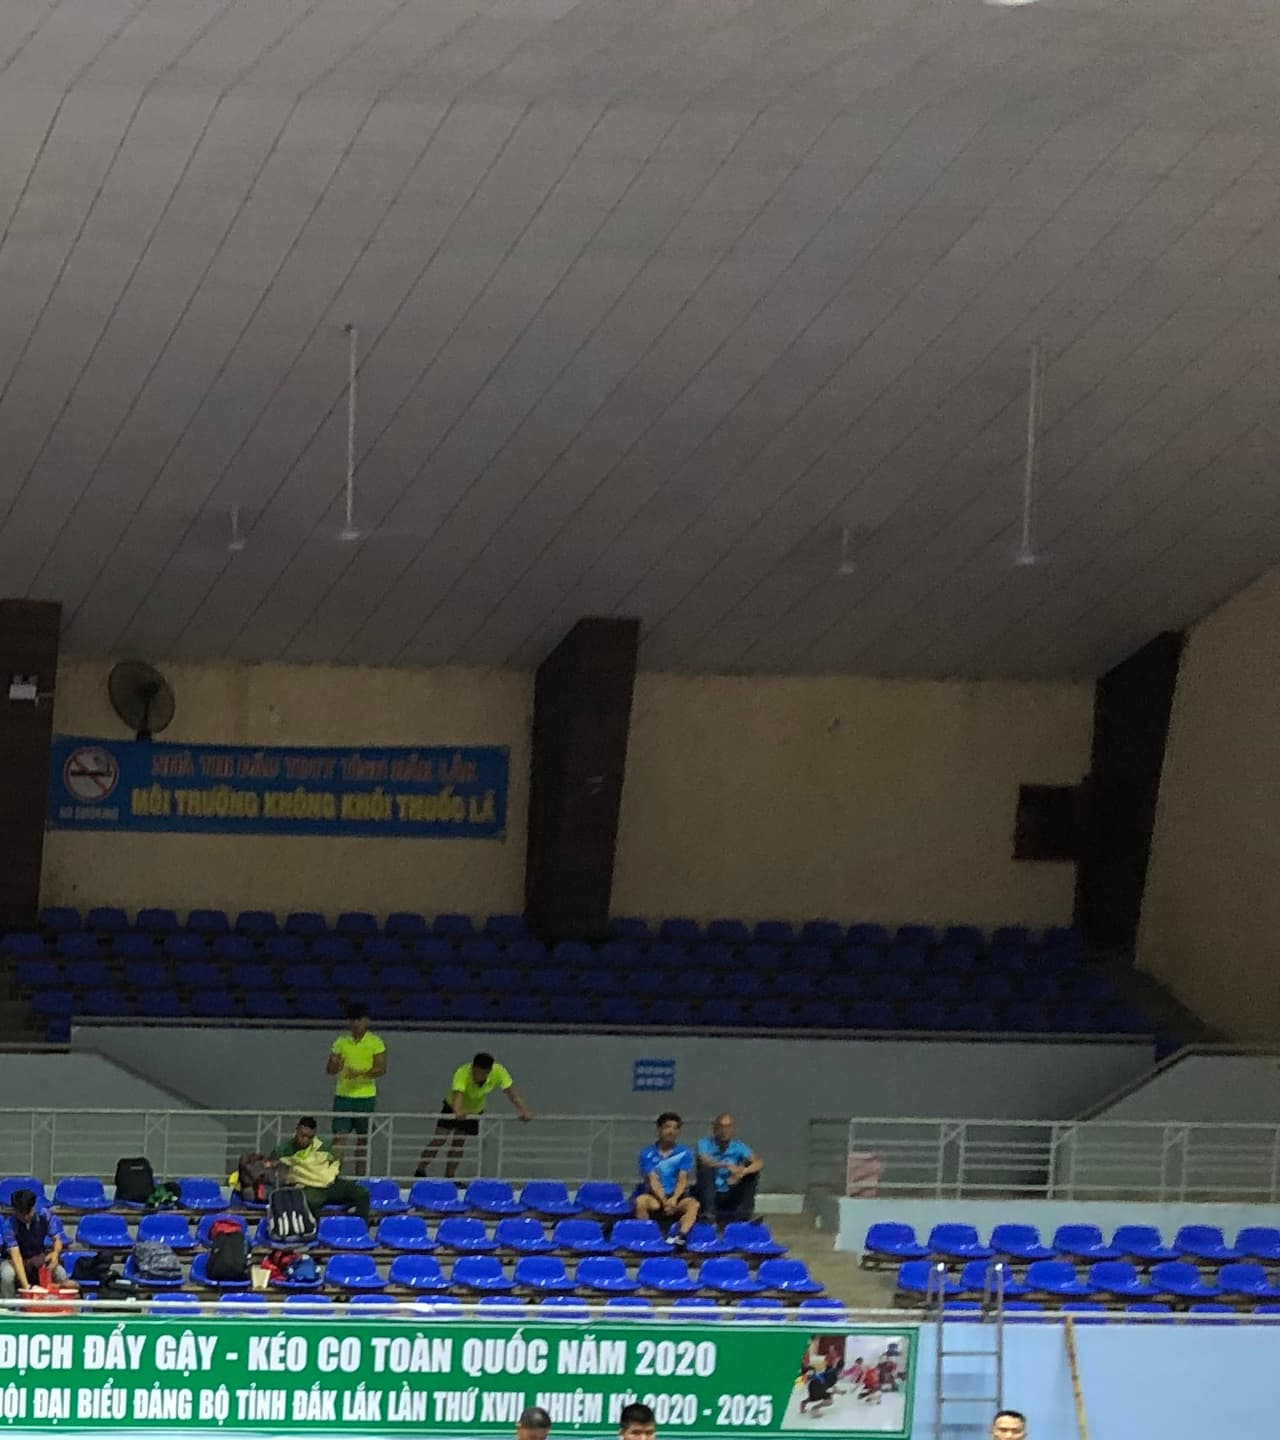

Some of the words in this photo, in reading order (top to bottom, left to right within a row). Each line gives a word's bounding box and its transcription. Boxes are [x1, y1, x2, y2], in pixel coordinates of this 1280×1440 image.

[83, 1322, 146, 1369] ĐẨY
[155, 1330, 218, 1376] GẬY
[248, 1331, 307, 1371] KÉO
[317, 1337, 361, 1372] CO
[371, 1333, 452, 1372] TOÀN
[462, 1328, 547, 1377] QUỐC
[557, 1334, 627, 1376] NĂM
[635, 1341, 717, 1377] 2020
[33, 1388, 70, 1424] ĐẠI
[77, 1378, 127, 1419] BIỂU
[133, 1382, 192, 1419] ĐẢNG
[199, 1384, 228, 1425] BỘ
[236, 1382, 286, 1420] TỈNH
[292, 1381, 336, 1420] ĐẮK
[342, 1381, 383, 1421] LẮK
[387, 1381, 427, 1421] LẦN
[433, 1387, 479, 1422] THỨ
[536, 1388, 602, 1429] NHIỆM
[716, 1394, 772, 1426] 2025
